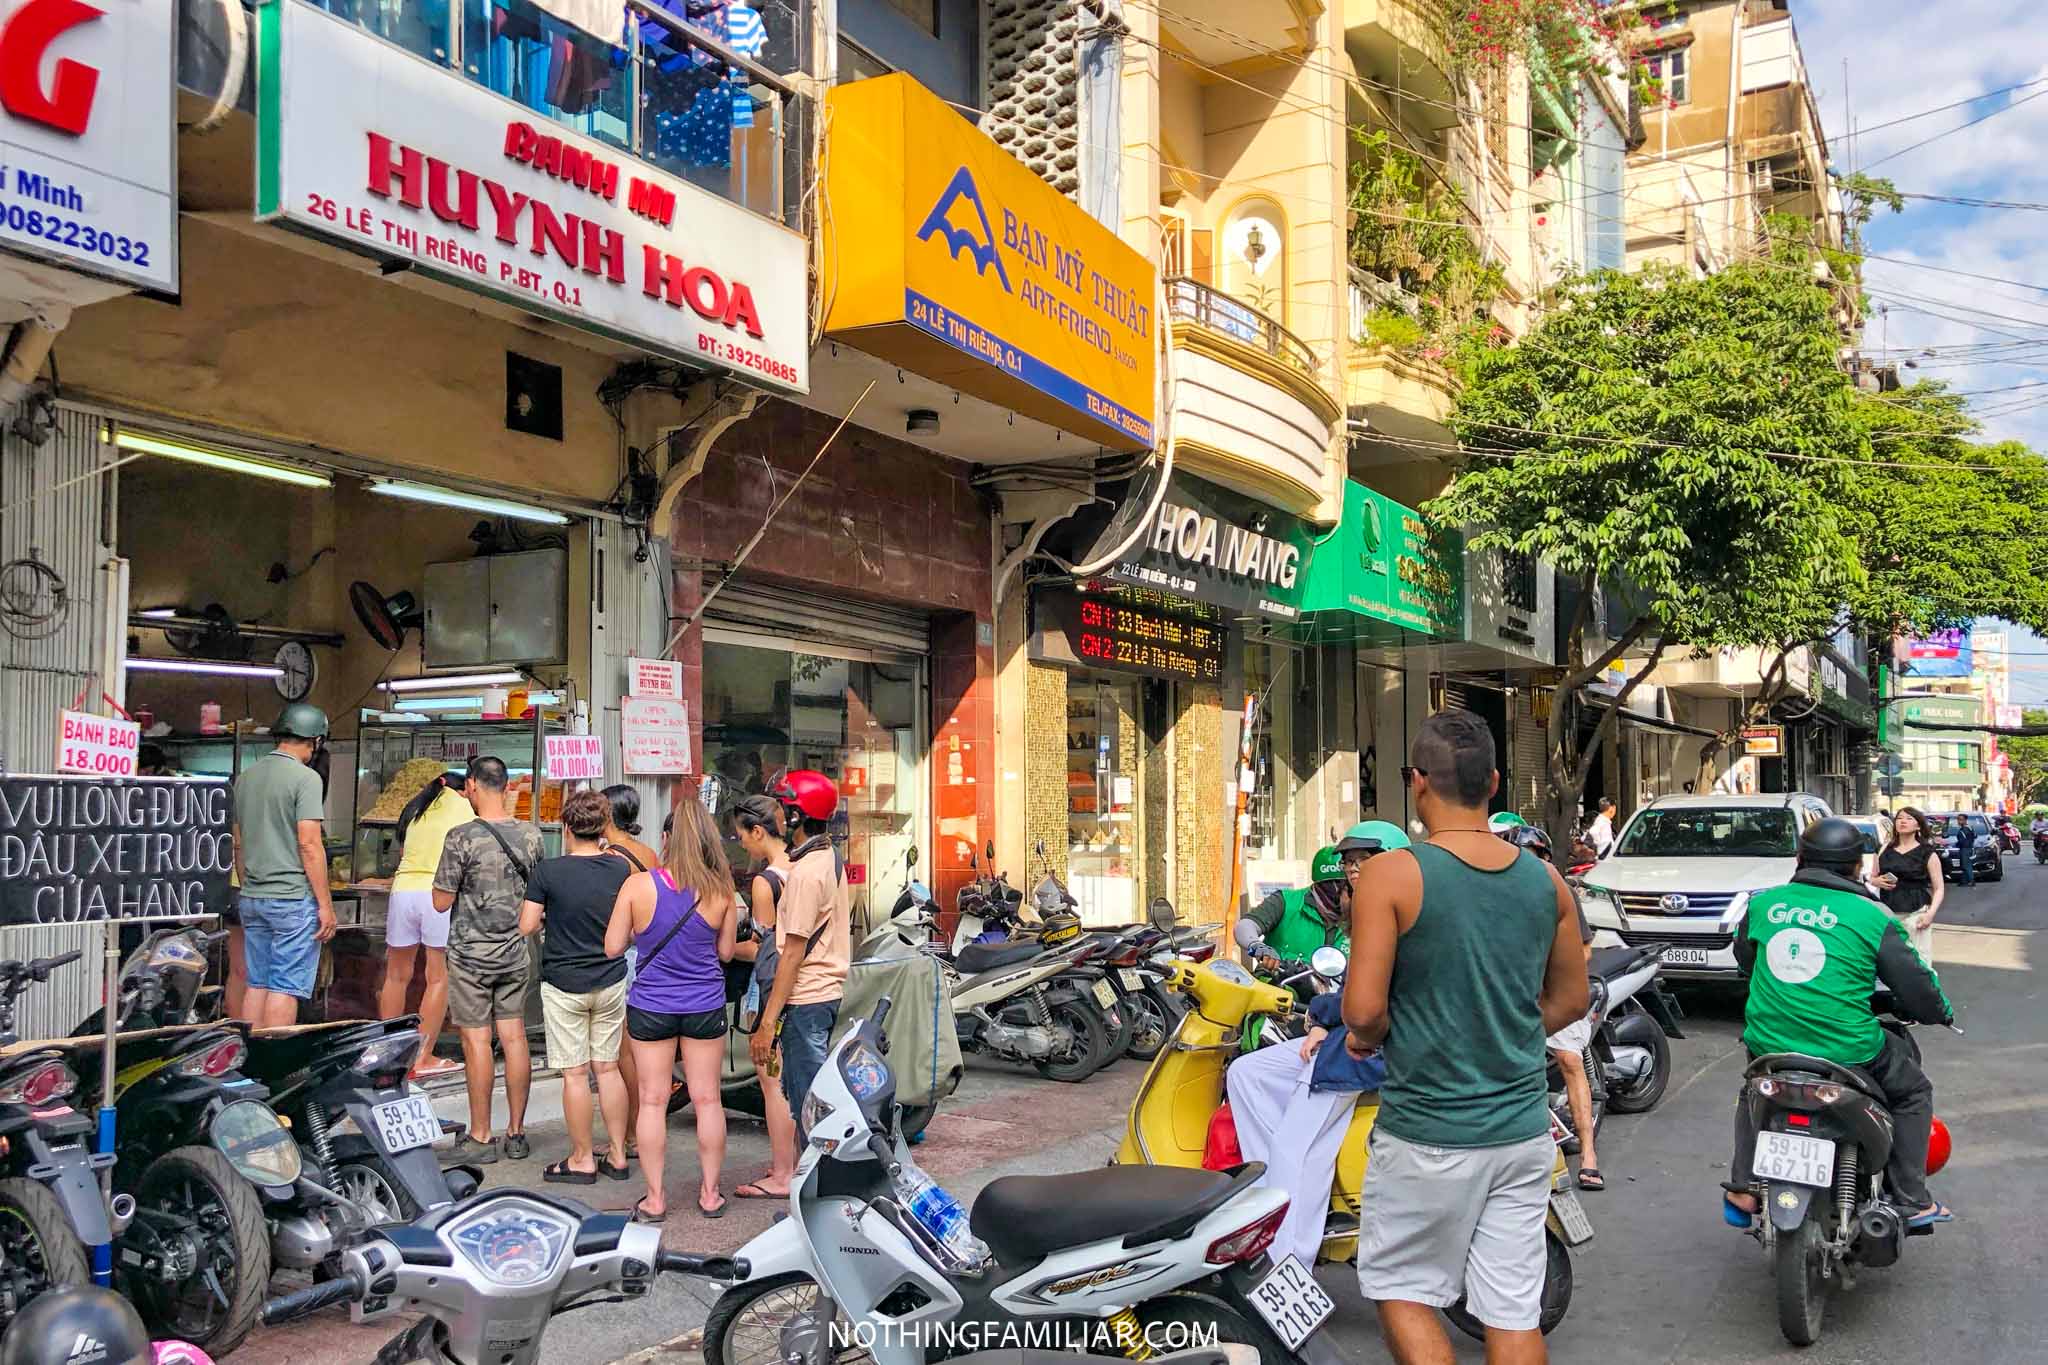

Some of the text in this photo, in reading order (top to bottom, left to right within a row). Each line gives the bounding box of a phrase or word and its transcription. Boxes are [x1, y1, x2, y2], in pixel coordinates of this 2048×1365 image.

[0, 0, 110, 137] G
[17, 169, 84, 214] Minh
[306, 193, 338, 222] 26
[345, 207, 374, 236] LÊ
[381, 219, 419, 256] THỊ
[425, 235, 489, 275] RIÊNG
[553, 280, 583, 307] Q.1
[366, 131, 765, 340] HUYNH HOA
[1003, 207, 1150, 340] BẠN MỸ THUẬT
[912, 299, 928, 323] 24
[929, 307, 945, 333] LÊ
[948, 316, 967, 347] THỊ
[1007, 350, 1023, 374] Q.1
[697, 332, 799, 385] ĐT: 39250885
[1152, 501, 1218, 567] HOA
[1081, 600, 1102, 627] CN
[1117, 610, 1133, 634] 33
[1081, 632, 1102, 658] CN
[1116, 640, 1132, 663] 22
[1135, 643, 1149, 665] Lê
[1151, 646, 1167, 672] Thị
[1168, 650, 1197, 678] Riêng
[108, 727, 137, 751] BAO
[64, 748, 132, 775] 18.000
[88, 833, 132, 874] XE
[1767, 903, 1839, 930] Grab
[1662, 950, 1705, 962] -689.04
[382, 1100, 426, 1127] 59-X2
[385, 1118, 436, 1149] 619.37
[1767, 1135, 1820, 1161] 59-U1
[1756, 1156, 1827, 1184] 467.16
[839, 1246, 881, 1256] HONDA
[1257, 1264, 1306, 1313] 59-T2
[1276, 1284, 1330, 1345] 218.63
